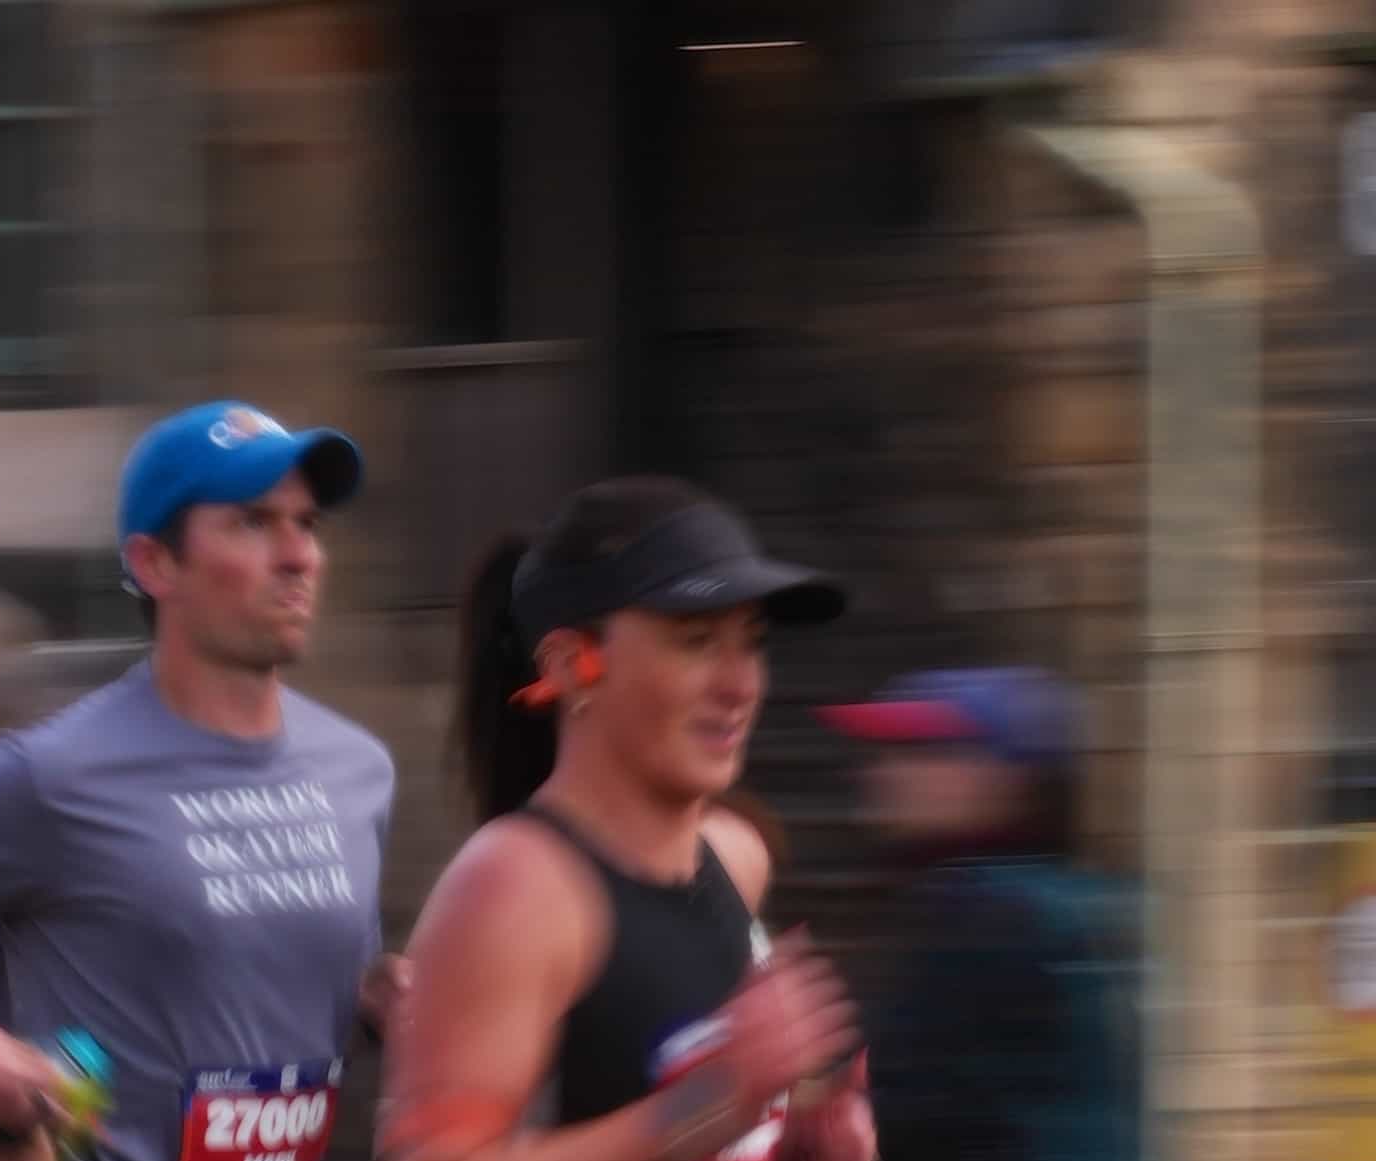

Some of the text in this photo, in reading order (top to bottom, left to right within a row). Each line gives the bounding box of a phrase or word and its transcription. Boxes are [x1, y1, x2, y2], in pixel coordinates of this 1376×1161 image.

[170, 782, 337, 828] WORLD'S
[201, 866, 354, 916] RUNNER
[205, 1089, 329, 1151] 27000
